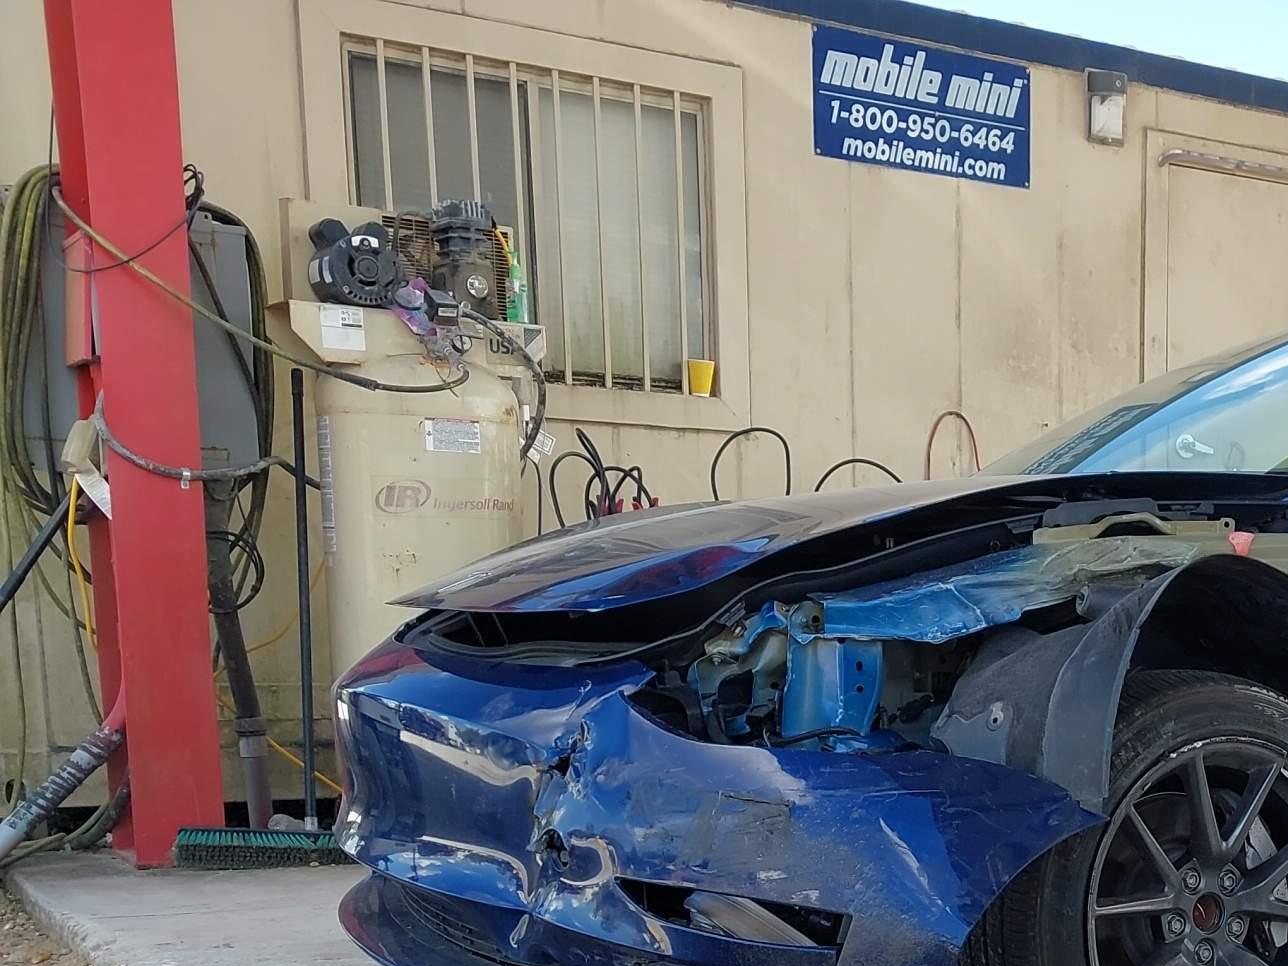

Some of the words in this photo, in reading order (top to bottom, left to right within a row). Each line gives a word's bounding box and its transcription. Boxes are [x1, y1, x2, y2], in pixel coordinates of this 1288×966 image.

[820, 43, 942, 104] mobile
[945, 72, 1024, 118] mini
[830, 99, 1015, 154] 1-800-950-6464
[841, 137, 1006, 180] mobilemini.com
[489, 337, 514, 355] US
